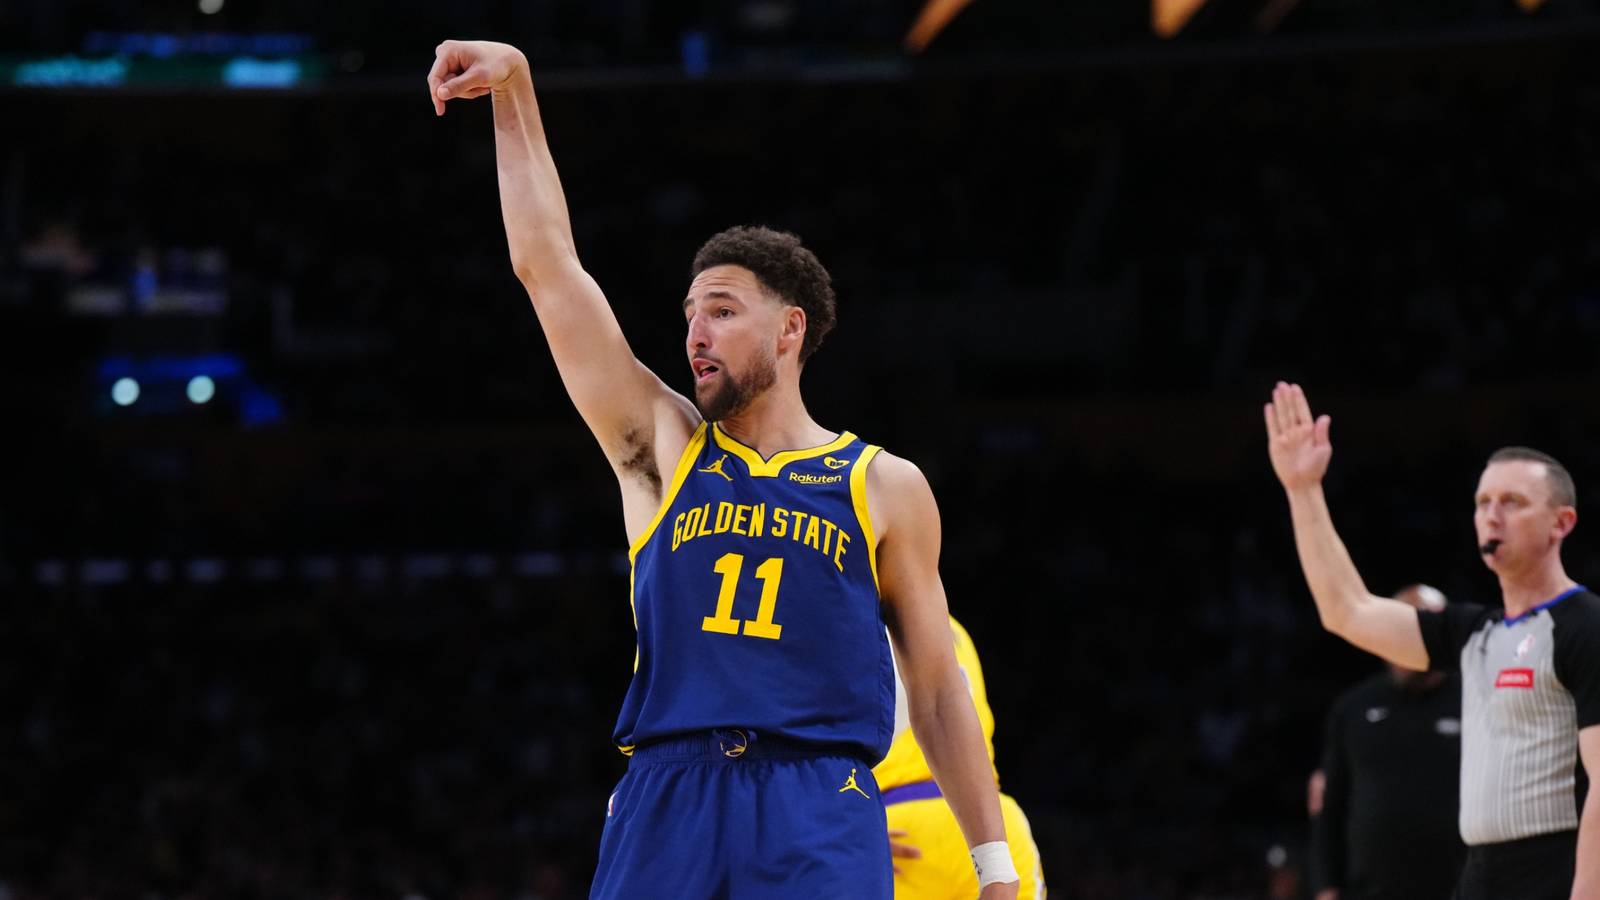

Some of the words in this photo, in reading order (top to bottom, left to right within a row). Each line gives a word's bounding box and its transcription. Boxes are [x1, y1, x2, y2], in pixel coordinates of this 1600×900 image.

[789, 472, 842, 484] Rakuten
[671, 501, 766, 552] GOLDEN
[771, 507, 851, 573] STATE
[702, 552, 784, 640] 11
